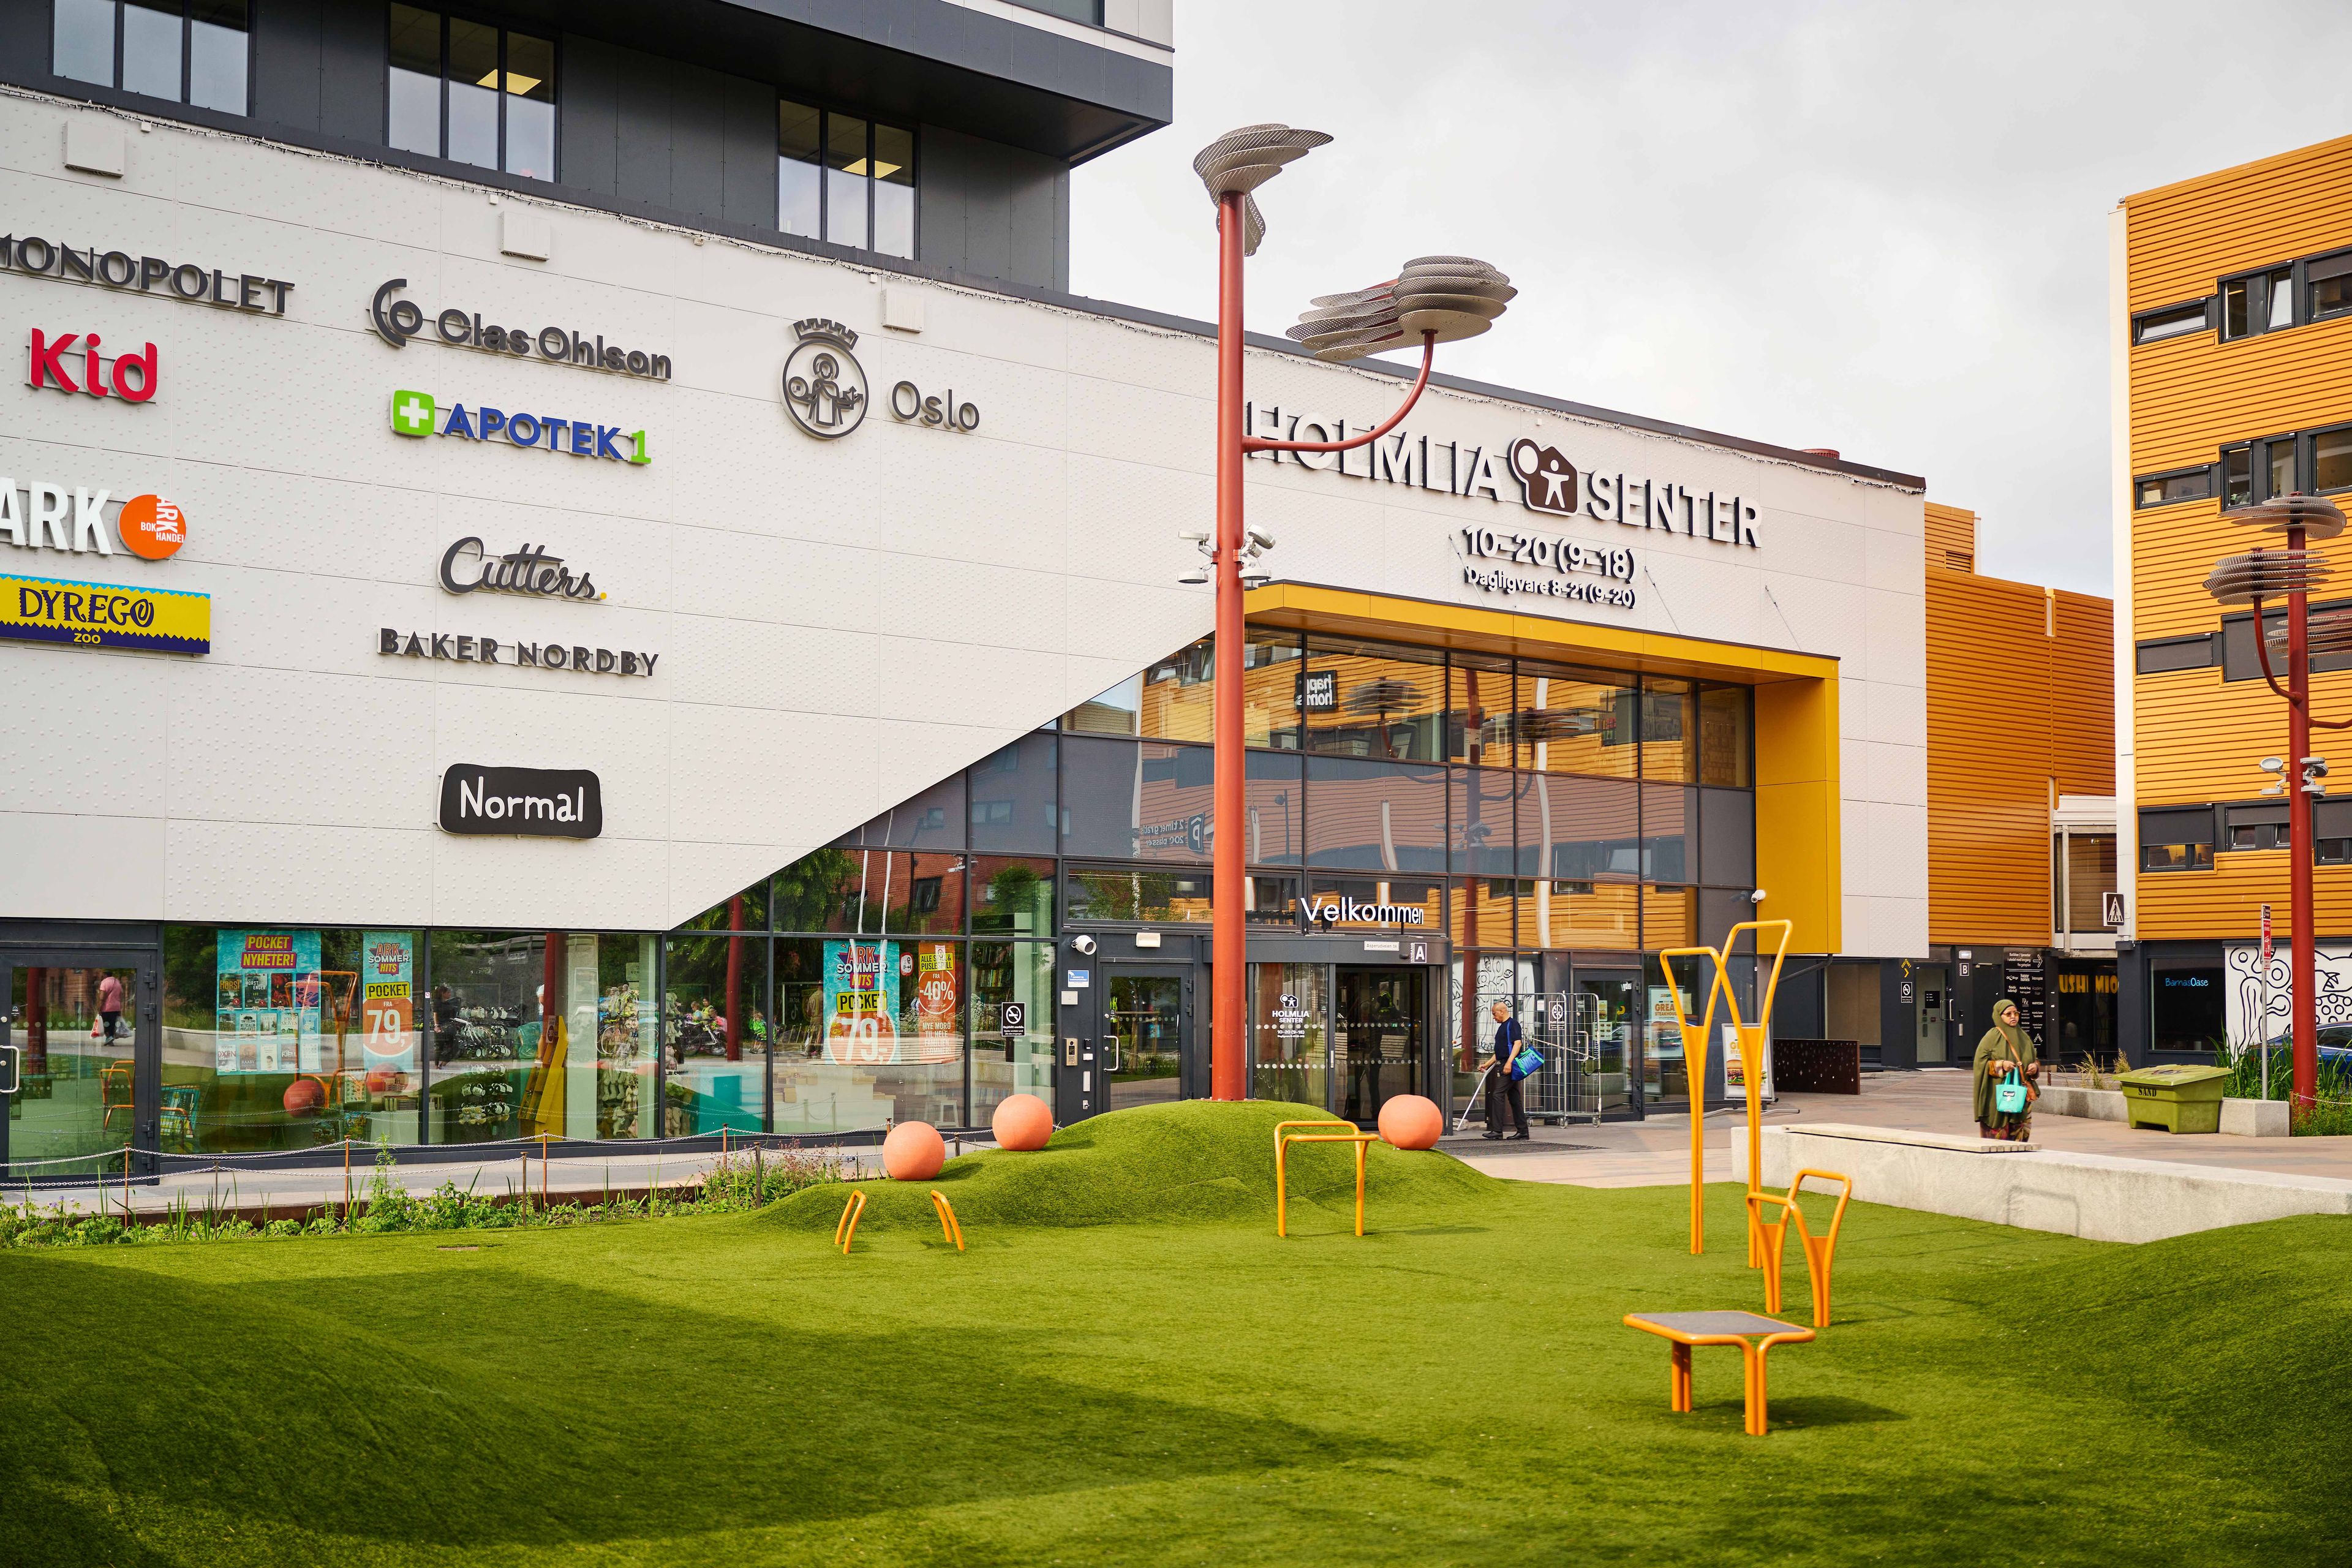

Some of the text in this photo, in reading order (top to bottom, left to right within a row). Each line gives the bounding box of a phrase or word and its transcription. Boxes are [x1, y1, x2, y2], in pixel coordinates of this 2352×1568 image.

[435, 309, 671, 380] Clas Ohlson
[29, 328, 157, 402] Kid
[889, 380, 980, 431] Oslo
[442, 403, 652, 464] APOTEK 1
[1248, 401, 1763, 548] HOLMLIA SENTER
[0, 477, 113, 555] ARK
[140, 521, 157, 532] BOK
[1464, 566, 1551, 595] Dagligvare
[18, 587, 155, 628] DYREGO
[74, 632, 101, 645] ZOO
[379, 627, 659, 677] BAKER NORDBY
[460, 776, 584, 822] Normal
[1300, 896, 1424, 925] Velkommen
[247, 936, 290, 949] POCKET
[376, 942, 400, 957] ARK
[243, 953, 295, 967] NYHETER!
[368, 955, 410, 963] SOMMER
[847, 946, 876, 964] ARK
[1415, 946, 1425, 960] A
[380, 962, 397, 973] HITS
[837, 962, 888, 974] SOMMER
[1962, 965, 1968, 974] B
[368, 984, 408, 998] POCKET
[919, 981, 954, 1000] -40%
[2059, 974, 2118, 993] USH MIO
[1655, 1003, 1675, 1012] GREA
[367, 1009, 409, 1047] 79,-
[2138, 1087, 2157, 1097] SAND
